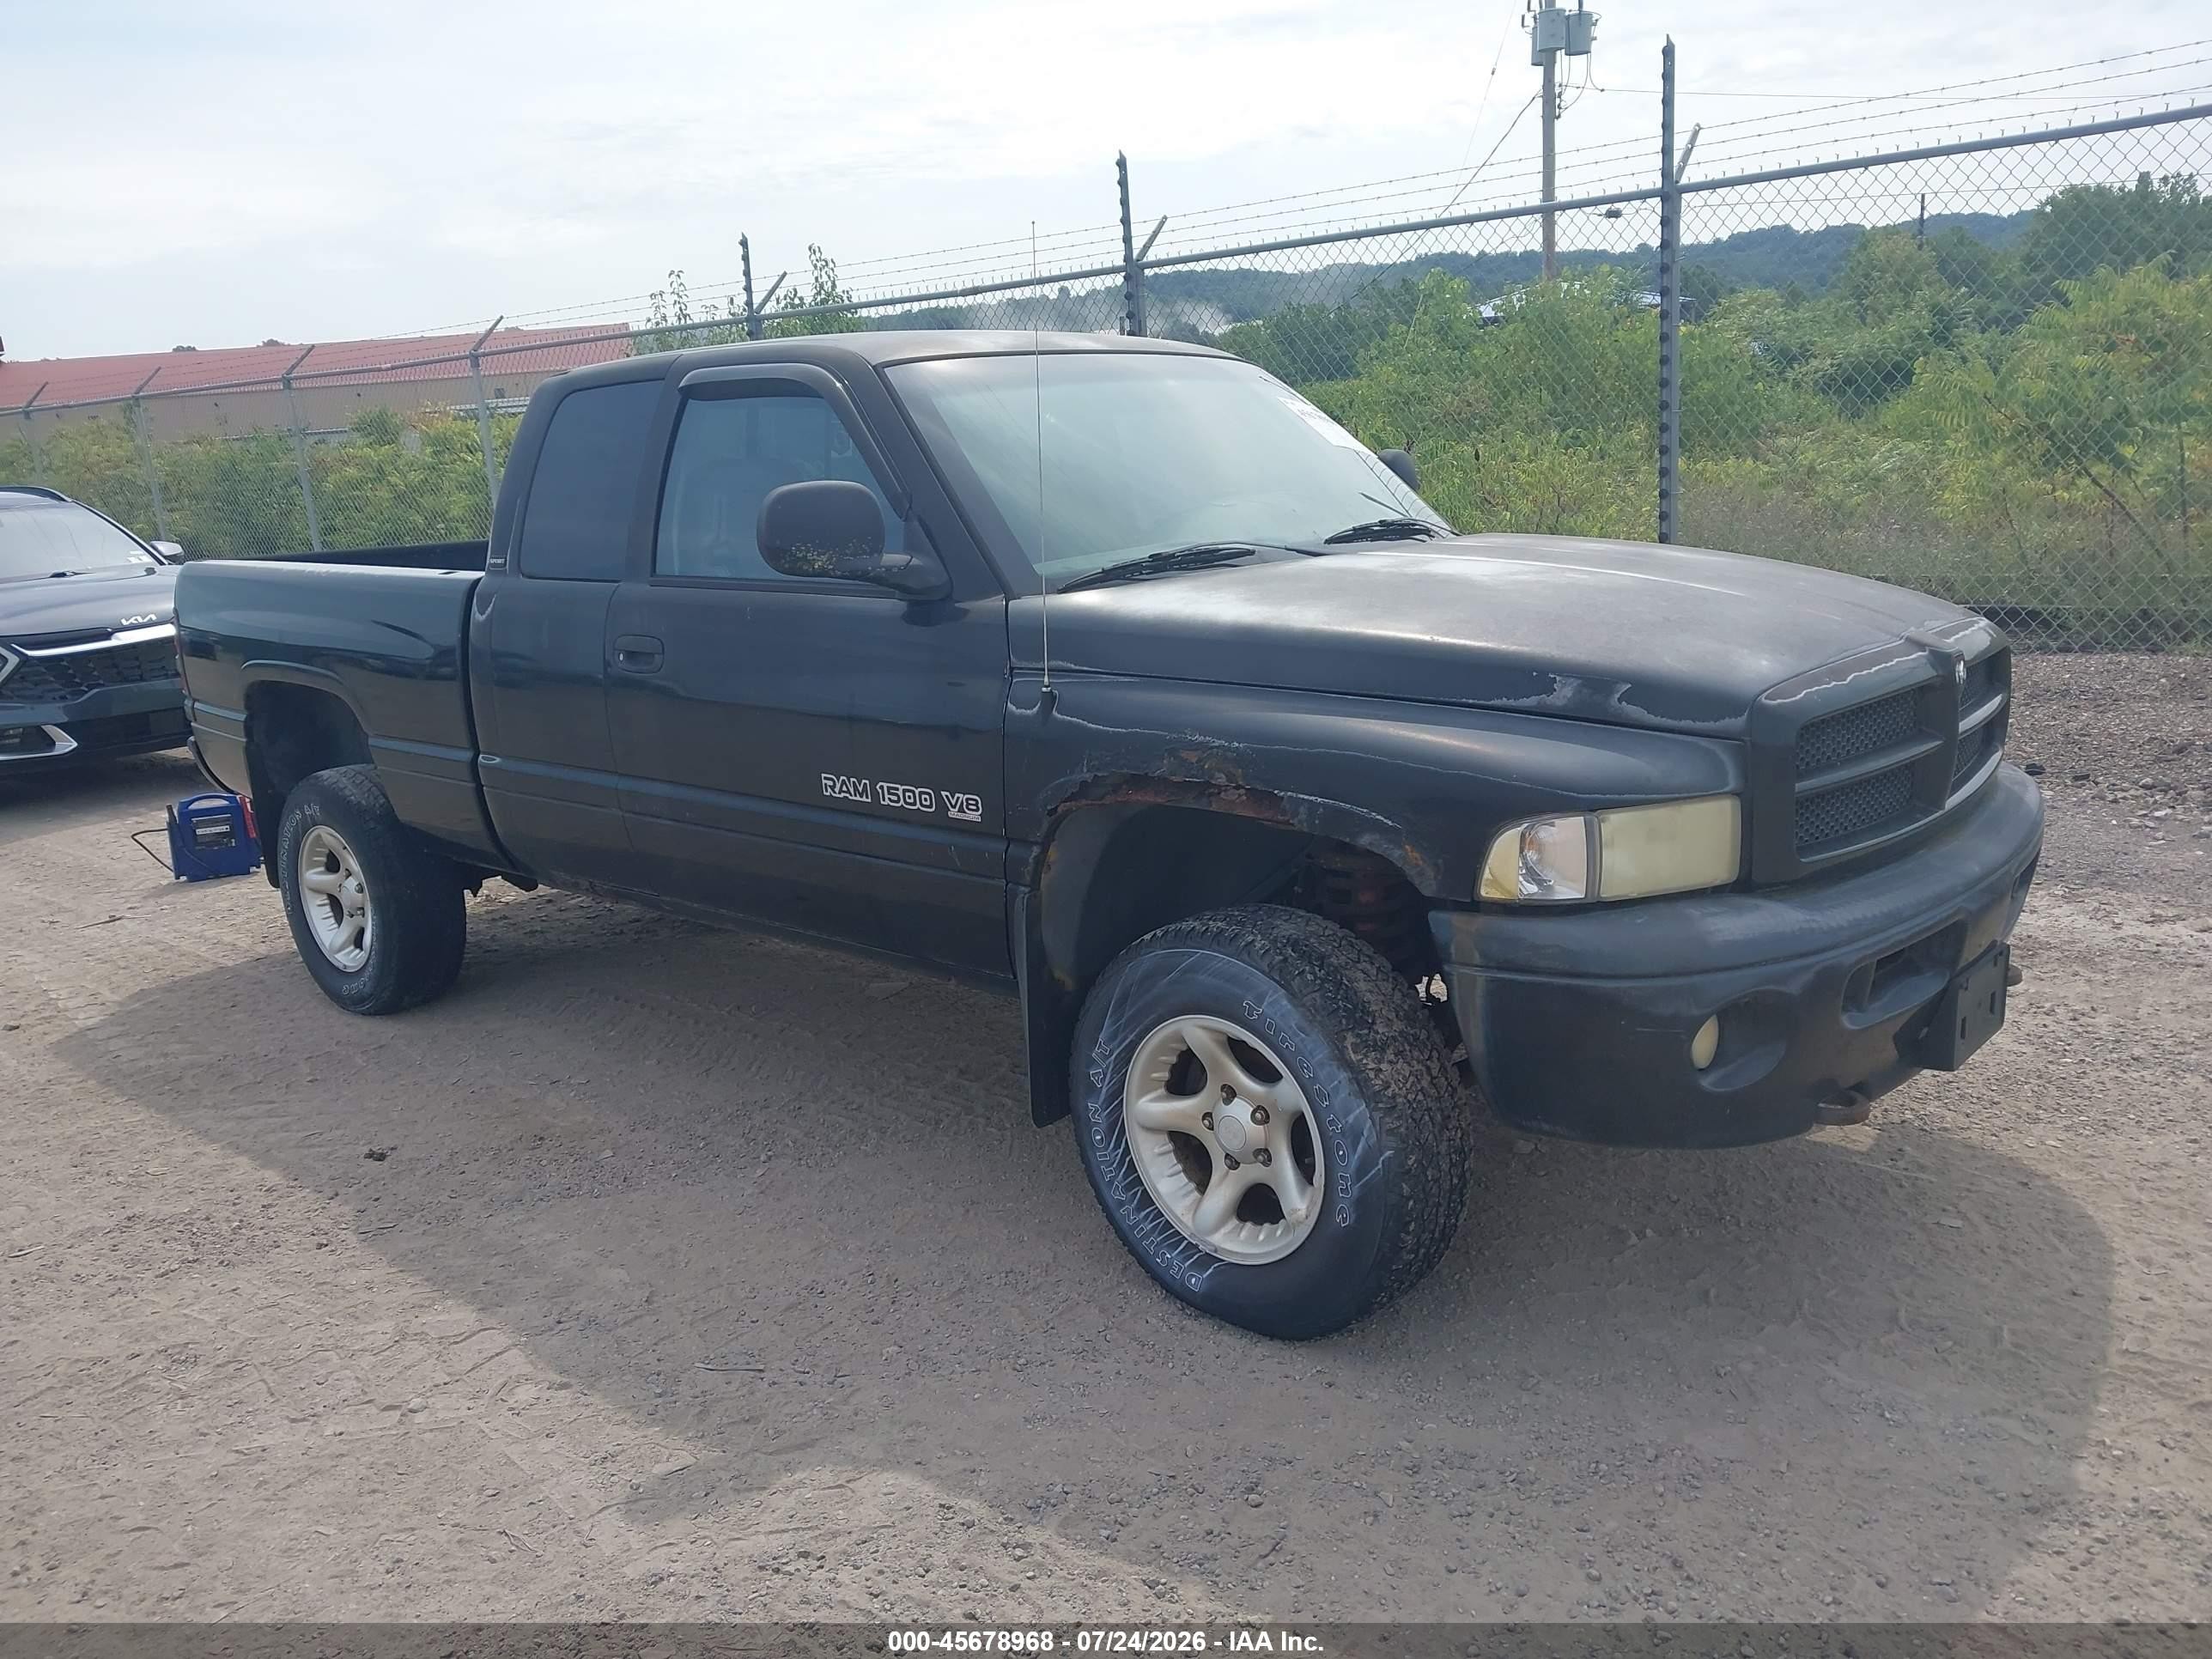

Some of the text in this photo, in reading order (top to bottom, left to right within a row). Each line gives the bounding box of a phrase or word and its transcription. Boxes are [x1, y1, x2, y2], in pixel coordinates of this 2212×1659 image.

[120, 613, 157, 626] KIA
[821, 773, 983, 816] RAM 1500 V8
[948, 811, 981, 822] MAGNUM
[1088, 1036, 1203, 1292] DESTINATION A/T
